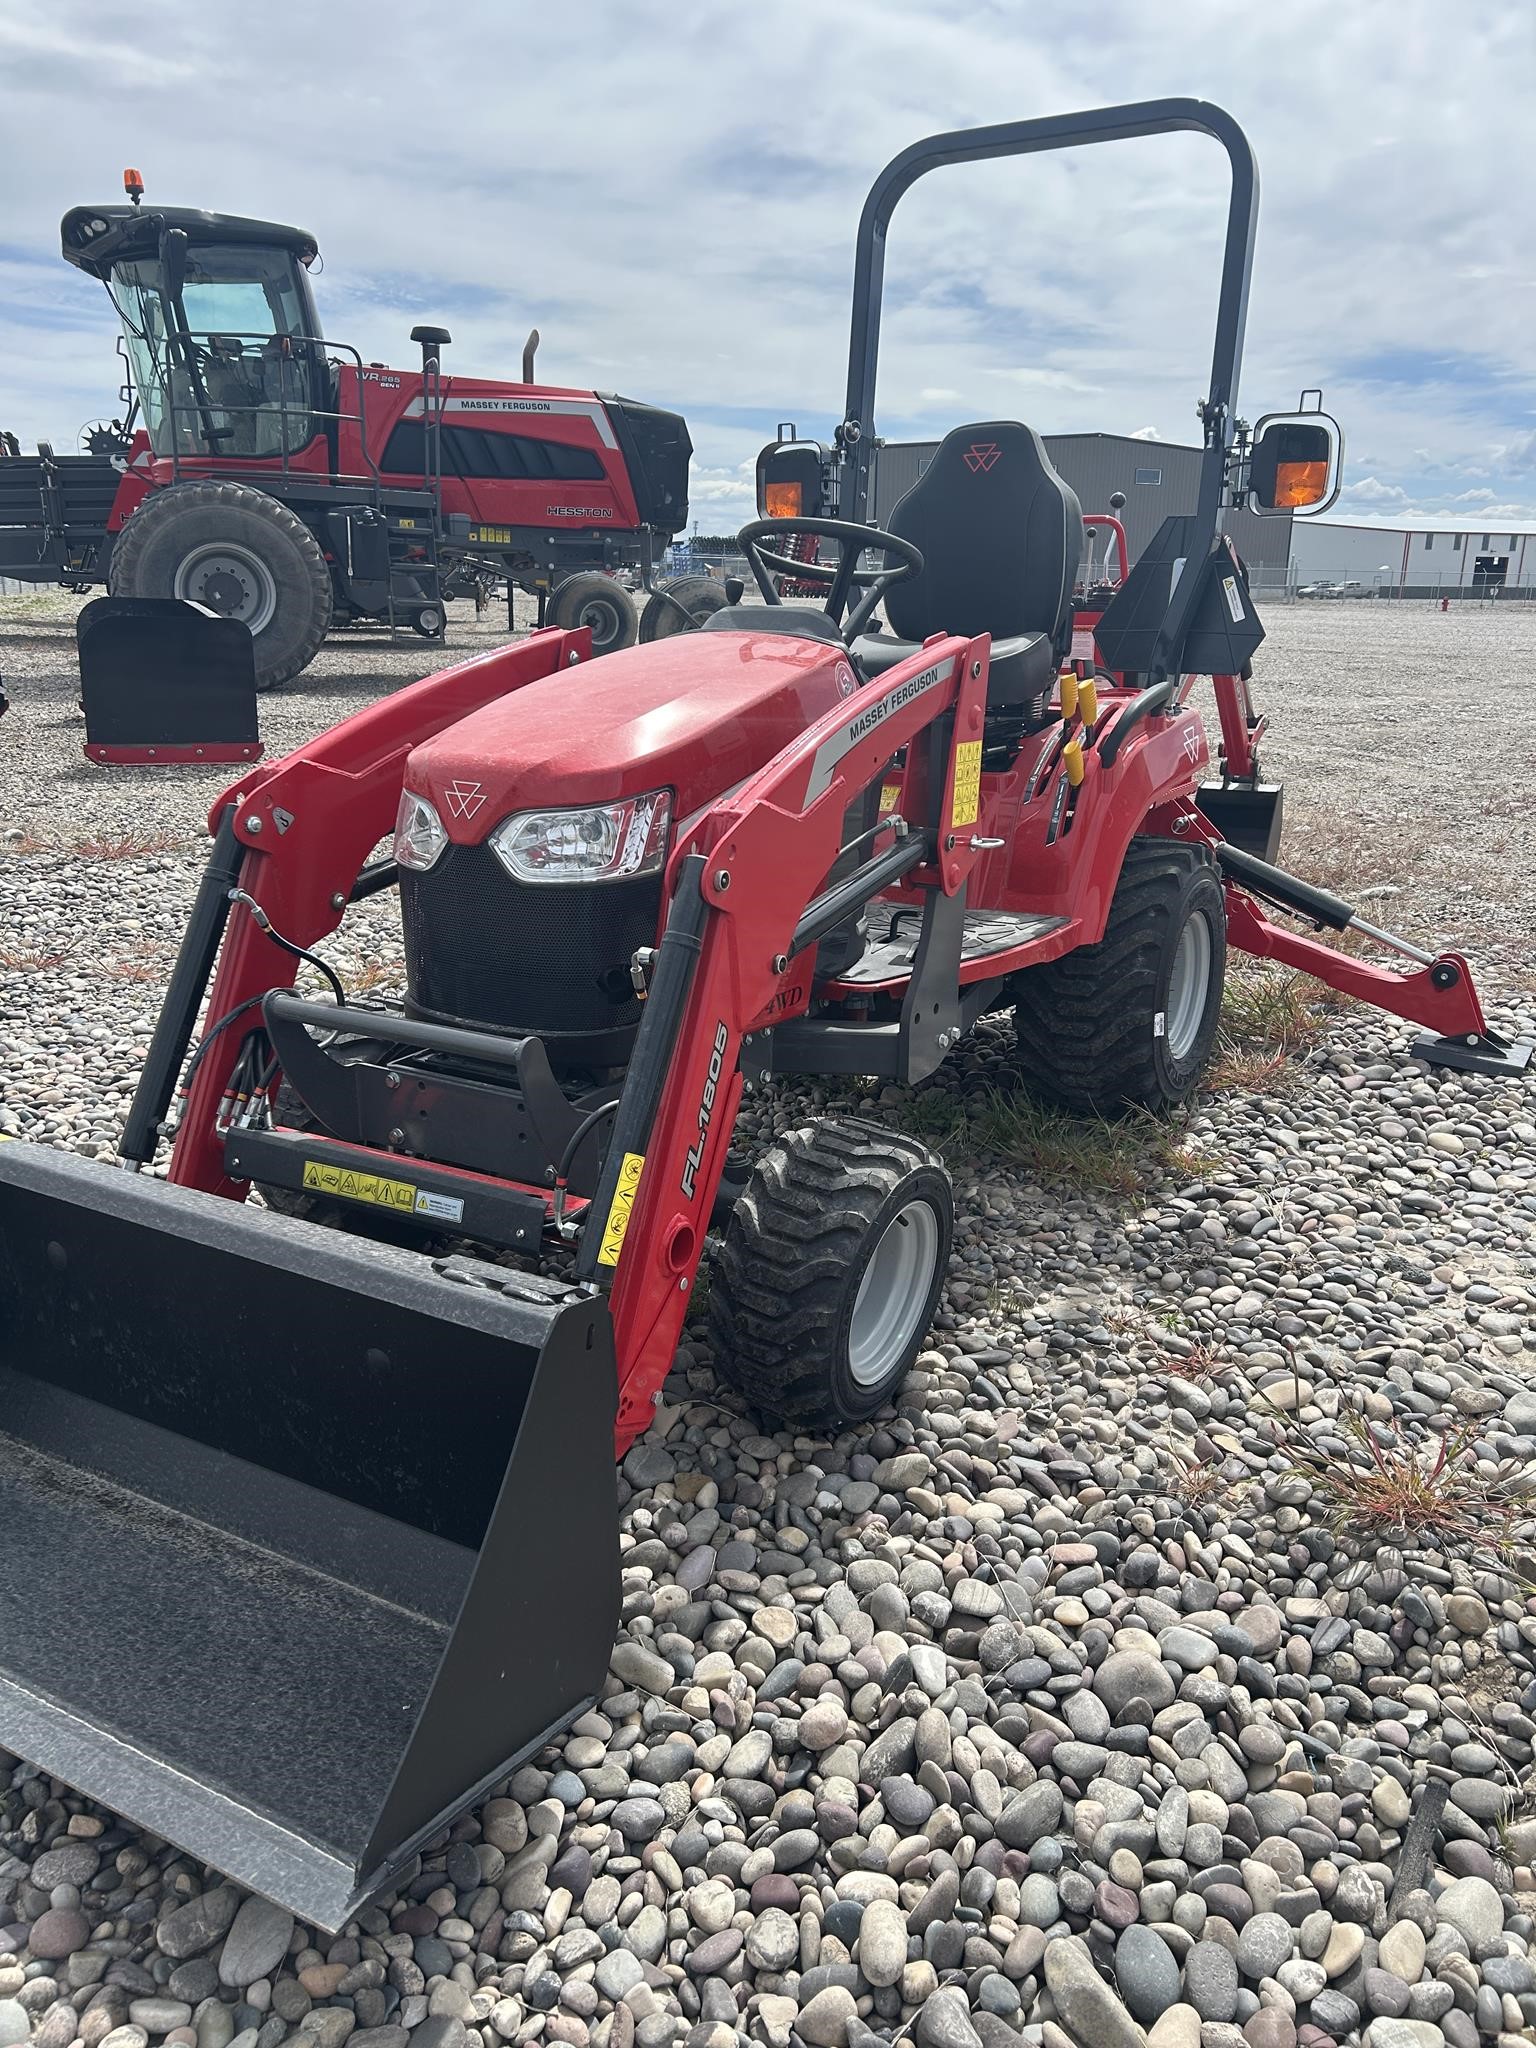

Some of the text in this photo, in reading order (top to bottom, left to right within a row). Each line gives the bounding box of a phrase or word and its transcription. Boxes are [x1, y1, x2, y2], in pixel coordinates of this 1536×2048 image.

[461, 401, 551, 411] MASSEY FERGUSON
[547, 506, 613, 518] HESSTON
[849, 668, 938, 741] MASSEY FERGUSON
